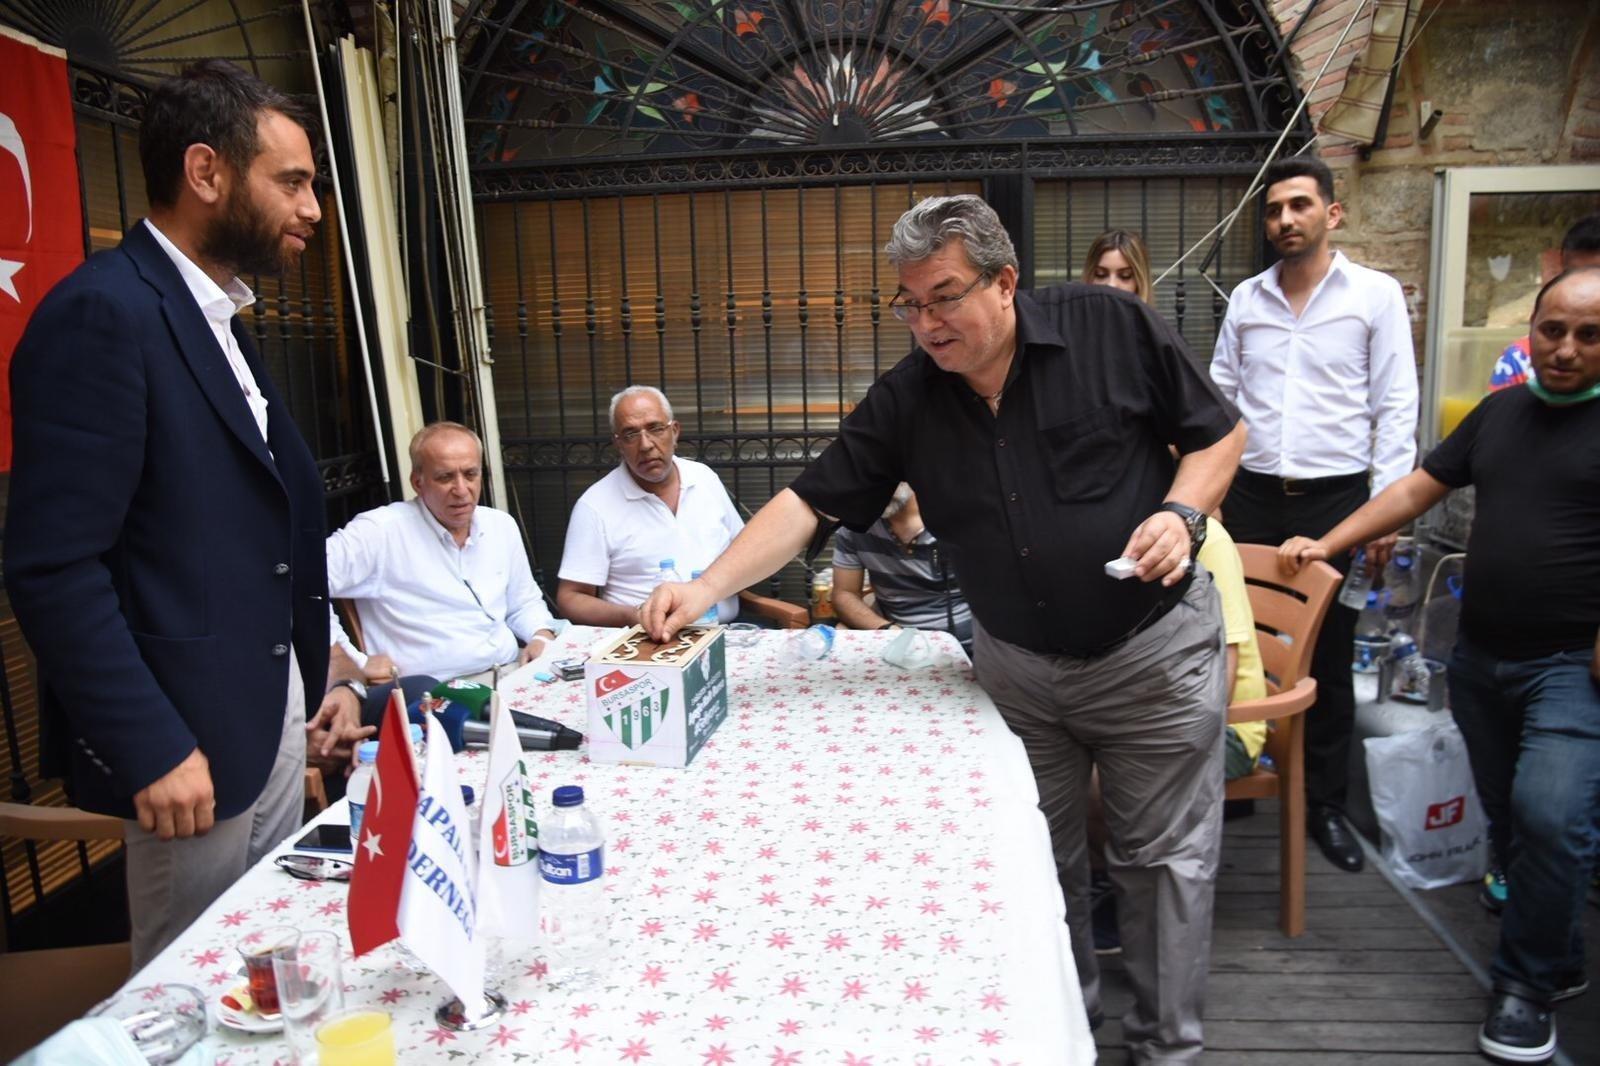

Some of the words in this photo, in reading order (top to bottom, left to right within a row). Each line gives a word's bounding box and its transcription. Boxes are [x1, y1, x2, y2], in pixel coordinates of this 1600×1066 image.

[602, 677, 652, 706] BURSASPOR
[621, 701, 660, 725] 1963
[1429, 801, 1460, 827] JF
